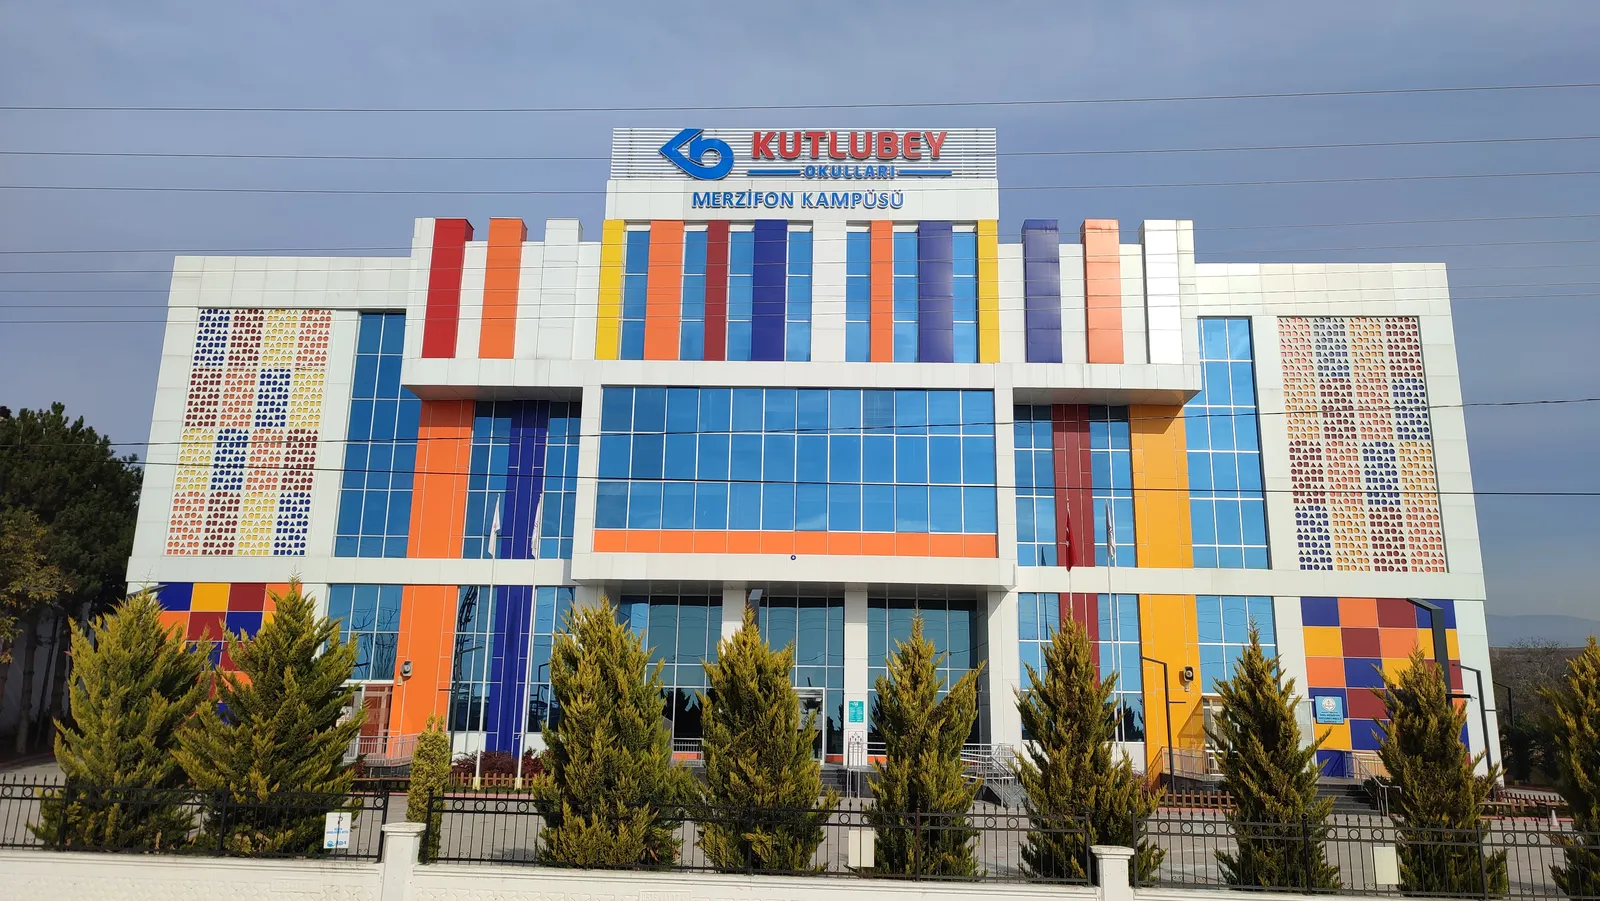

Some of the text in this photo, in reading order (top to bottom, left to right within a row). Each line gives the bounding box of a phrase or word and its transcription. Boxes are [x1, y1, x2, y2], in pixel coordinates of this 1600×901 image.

[752, 131, 948, 160] KUTLUBEY
[804, 164, 896, 179] OKULLARI
[692, 188, 905, 209] MERZİFON KAMPÜSÜ
